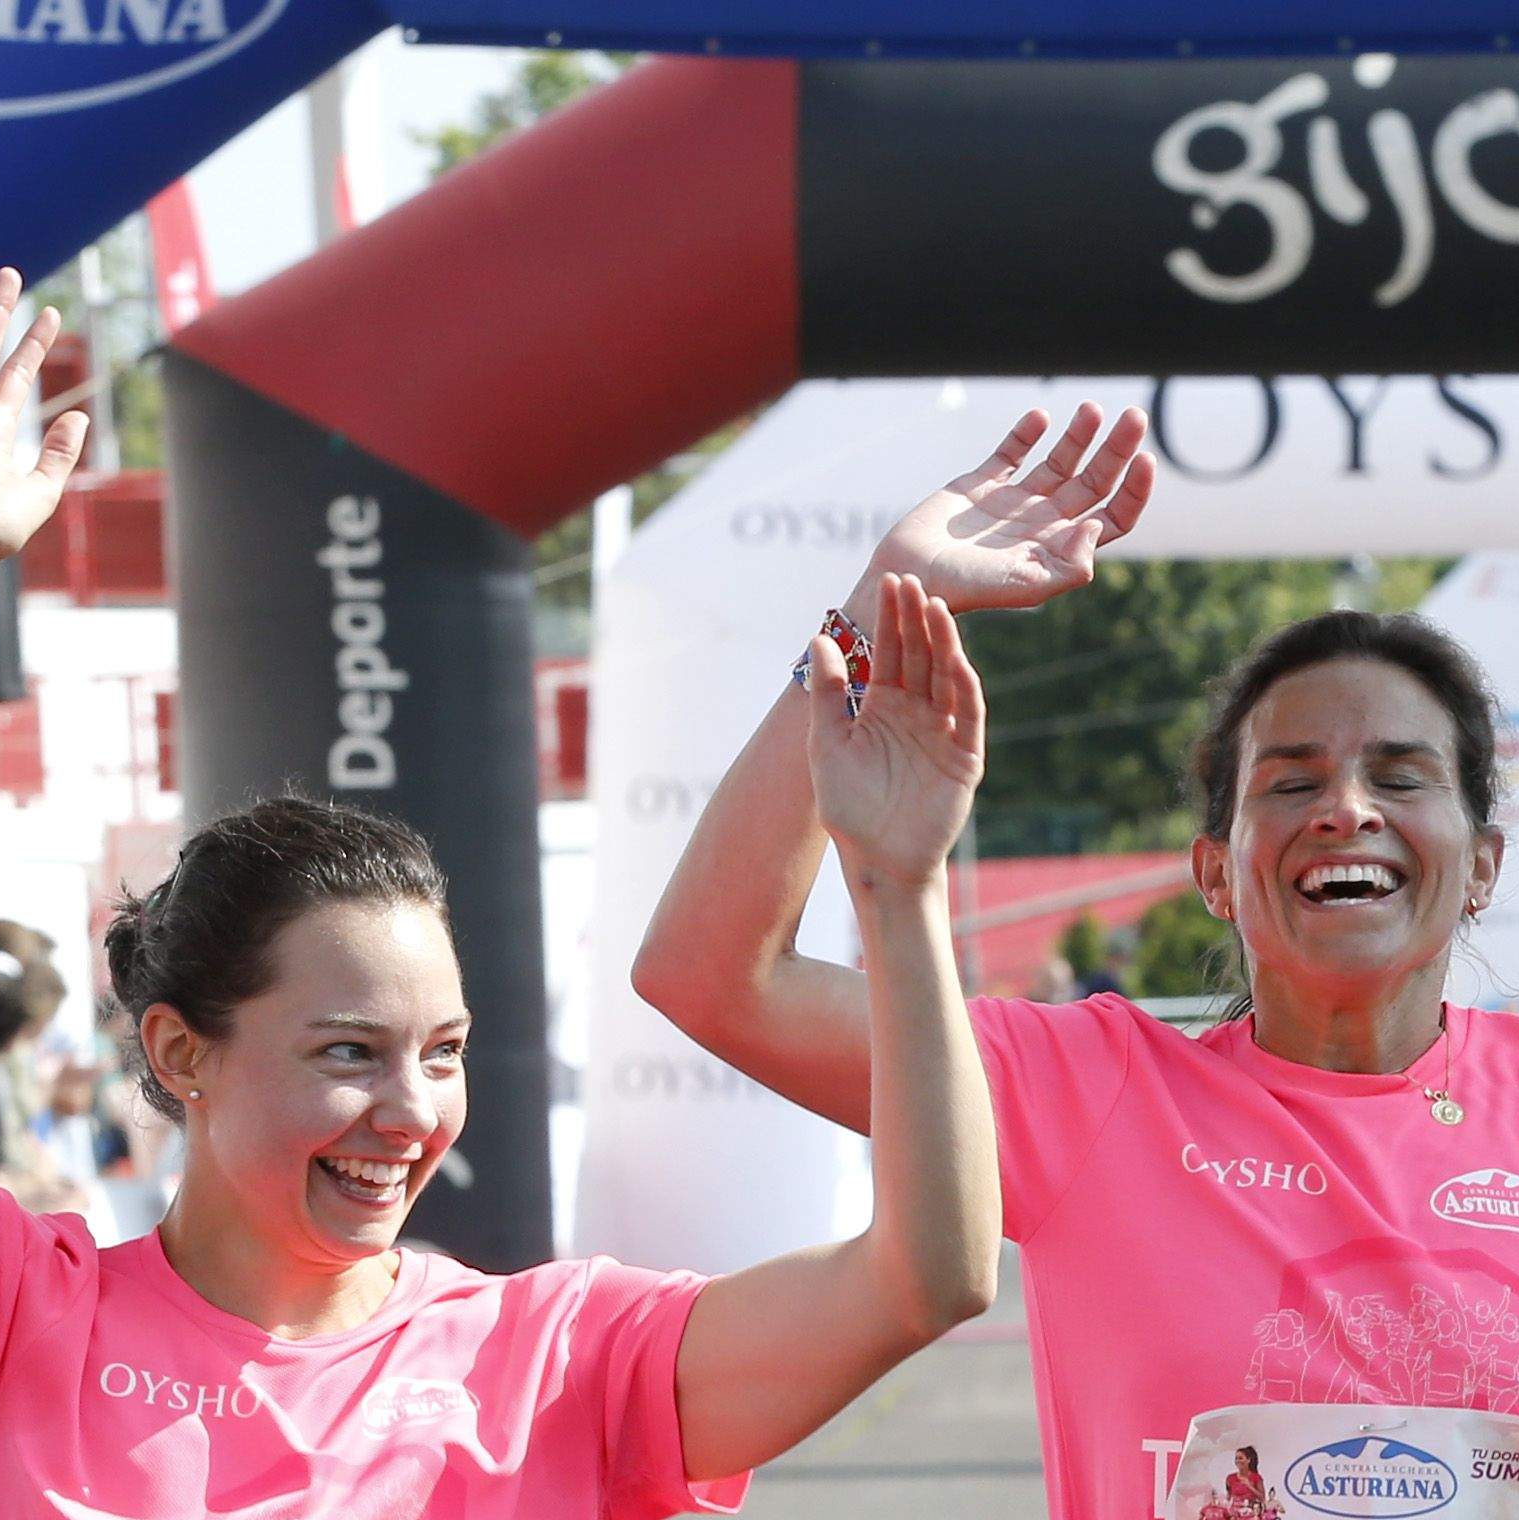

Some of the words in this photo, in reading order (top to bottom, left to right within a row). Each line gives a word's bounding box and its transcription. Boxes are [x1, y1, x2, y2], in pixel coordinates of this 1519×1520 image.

[317, 493, 411, 791] Deporte
[100, 1362, 262, 1419] OYSHO
[1325, 1463, 1378, 1474] CENTRAL
[1384, 1465, 1440, 1476] LECHERA
[1471, 1449, 1486, 1461] TU
[1297, 1465, 1445, 1500] ASTURIANA
